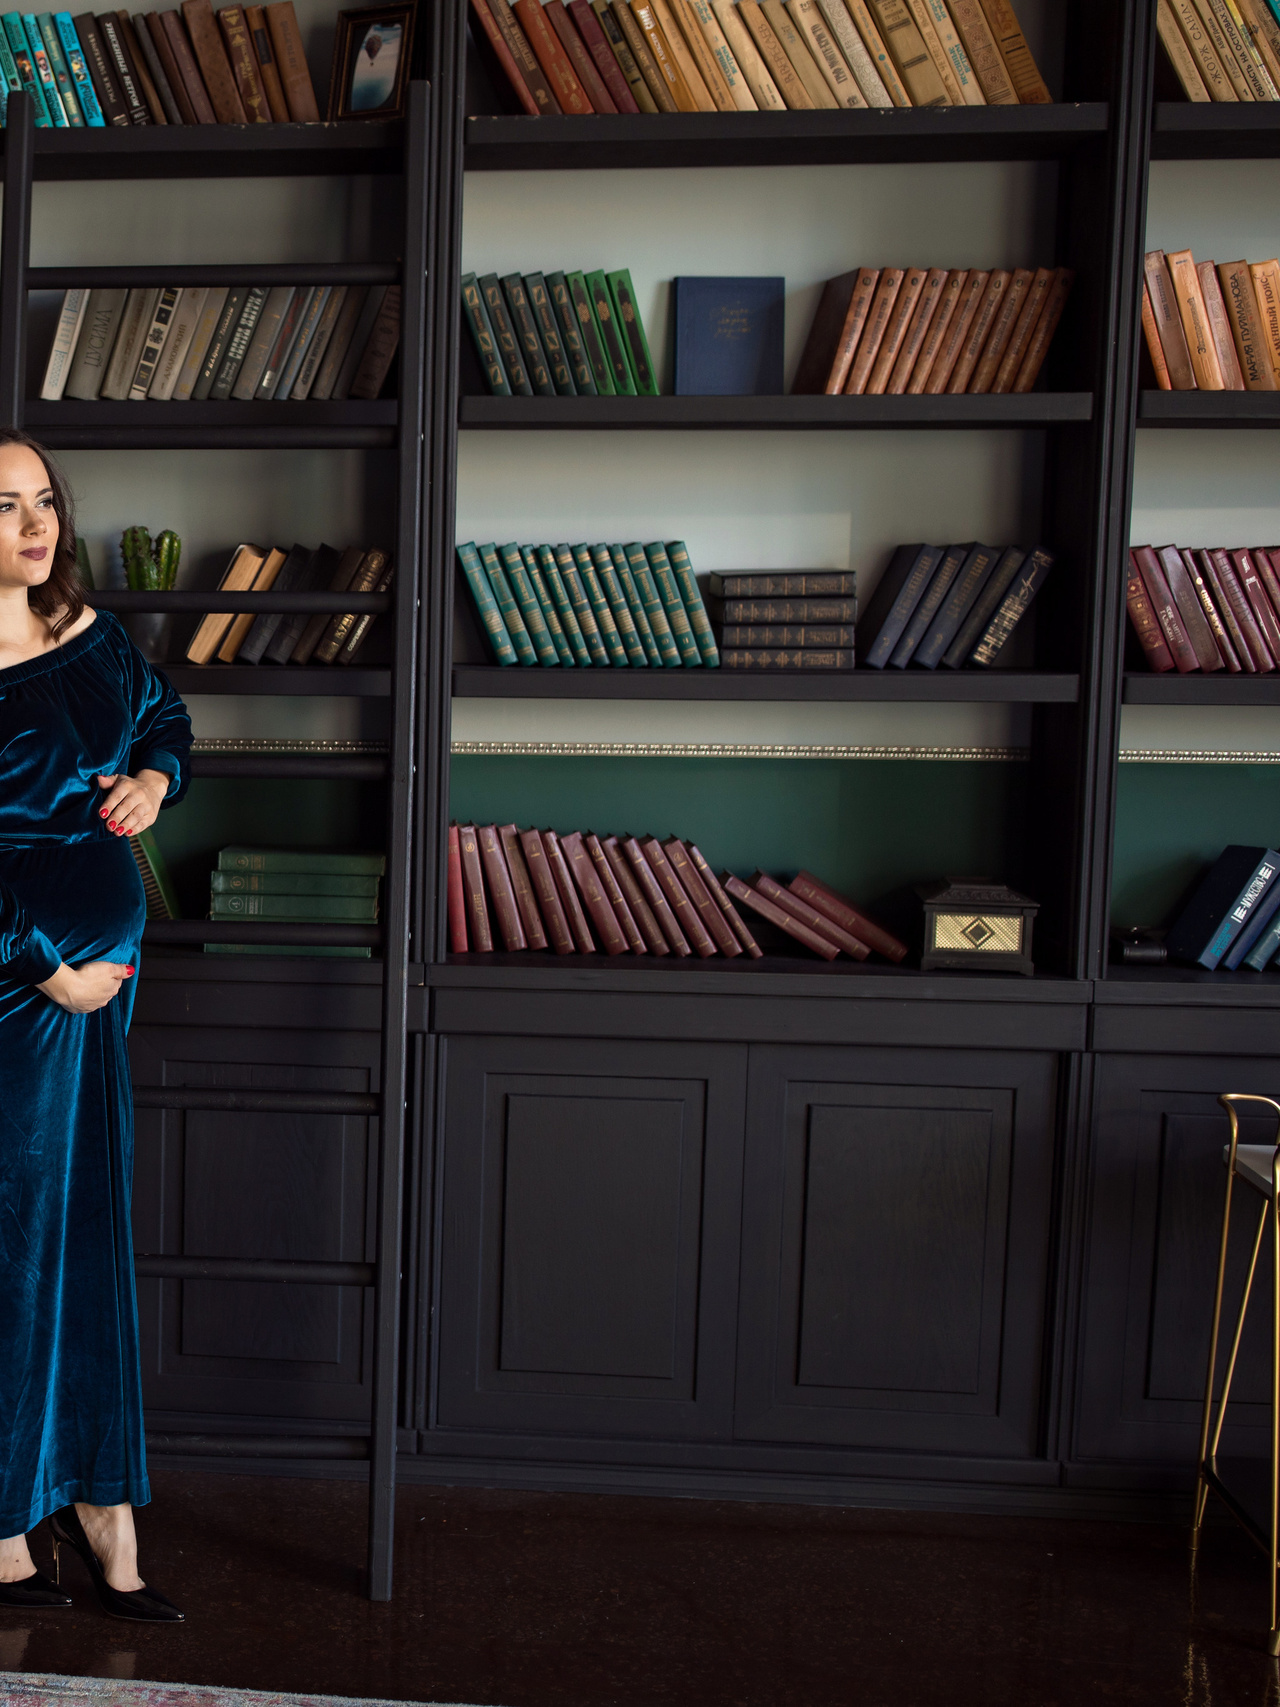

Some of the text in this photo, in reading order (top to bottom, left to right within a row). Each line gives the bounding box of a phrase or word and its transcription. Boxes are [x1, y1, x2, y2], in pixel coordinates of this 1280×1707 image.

[808, 22, 848, 84] ГРАФ МОНТЕ-КРИСТО
[1197, 43, 1223, 83] ЖОРЖ
[1219, 11, 1266, 97] ОБЛАСТЬ НА ОСТРОВАХ
[122, 73, 139, 107] ВЕТРОМ
[1260, 277, 1274, 303] ПОЯС
[82, 305, 116, 368] ЦУСИМА
[227, 294, 262, 360] СЕСТРА КЕРРИ
[1228, 272, 1259, 381] МАРИЯ ПУЙМАНОВА
[1239, 874, 1266, 908] МУЖЕСТВО
